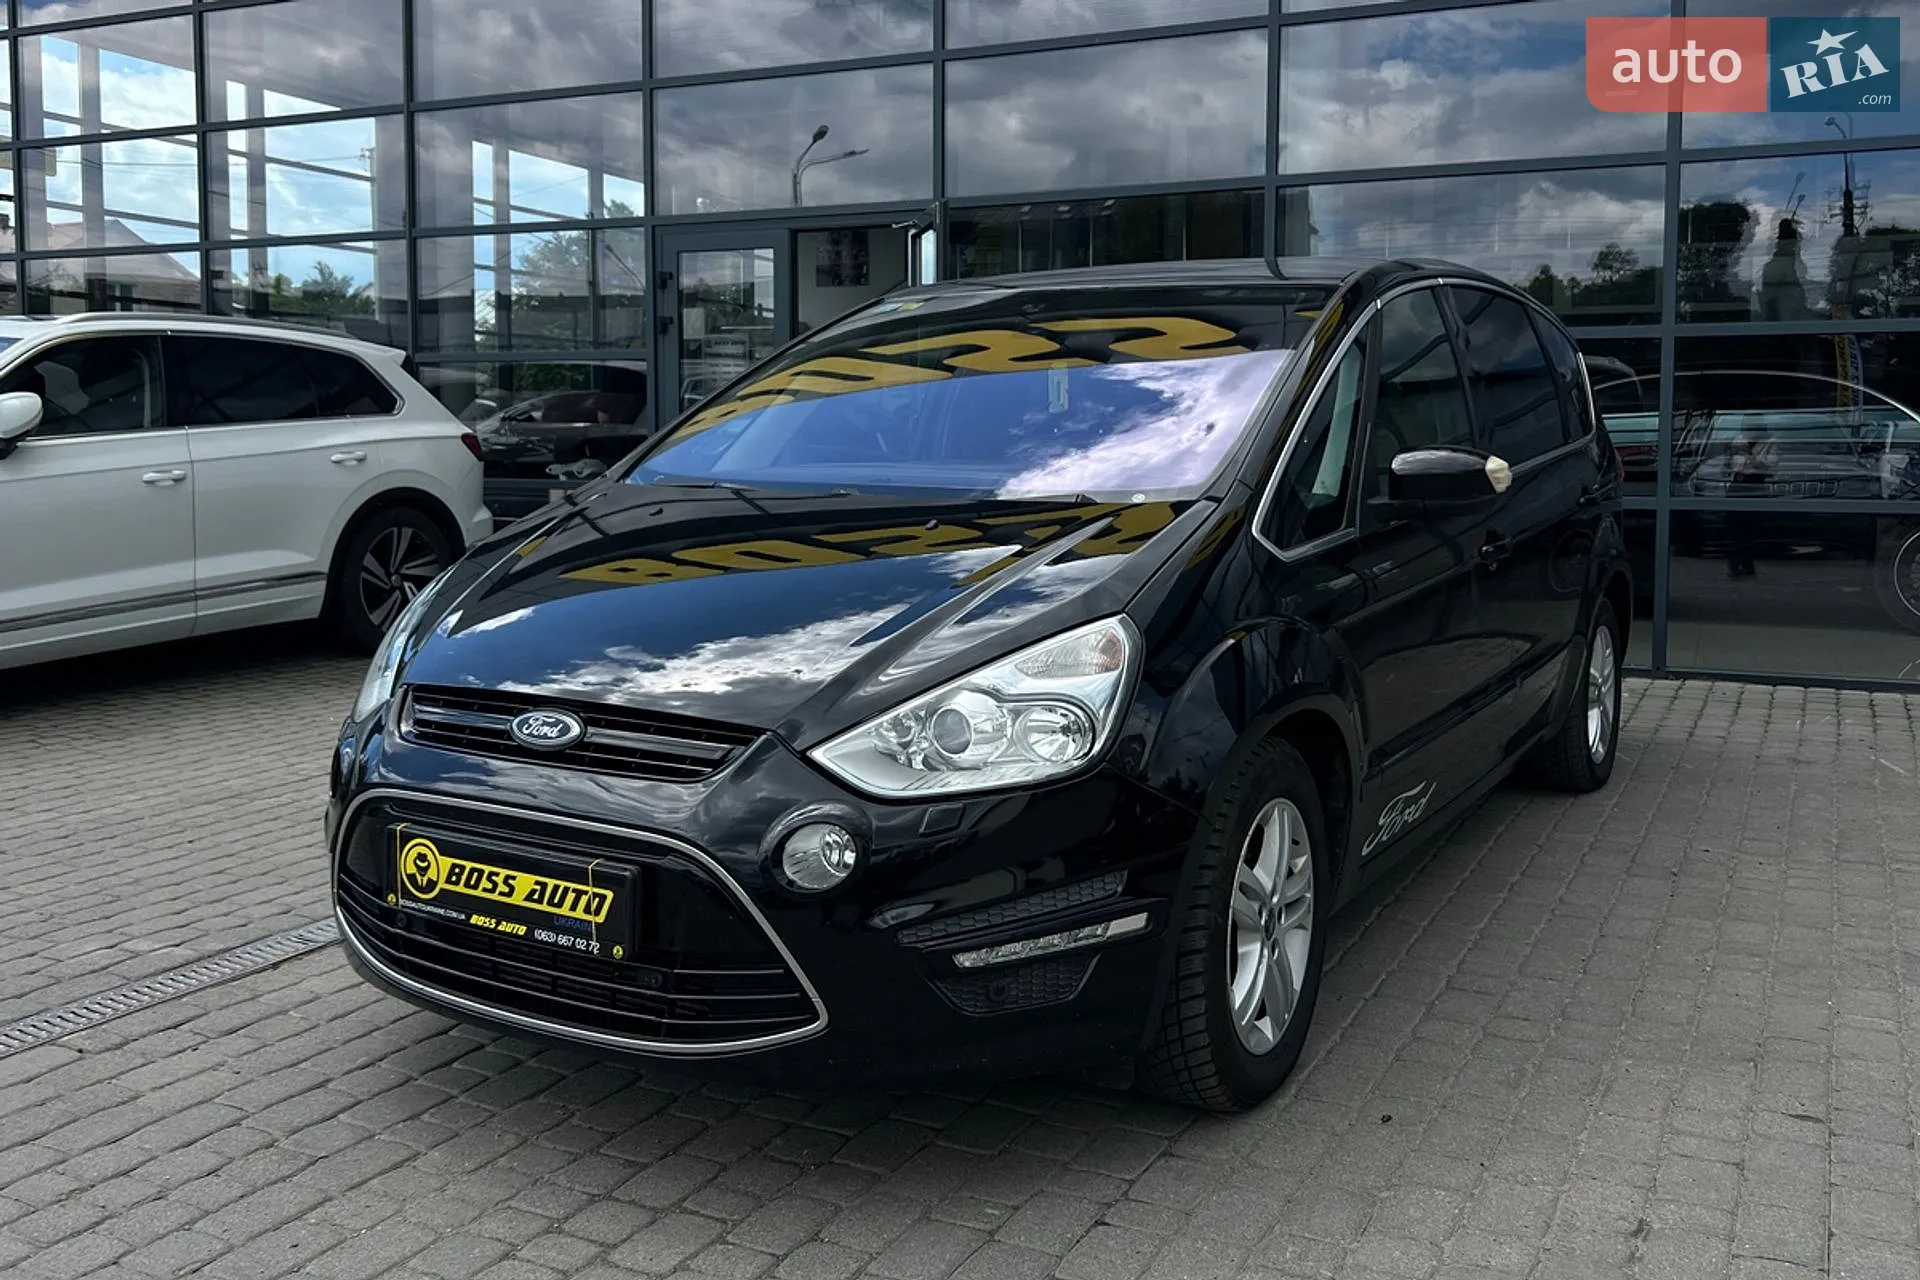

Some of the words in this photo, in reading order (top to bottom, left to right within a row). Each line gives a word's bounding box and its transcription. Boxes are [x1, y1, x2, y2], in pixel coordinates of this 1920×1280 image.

[523, 716, 563, 737] Ford
[1361, 780, 1438, 856] Ford
[445, 862, 517, 898] BOSS
[525, 880, 608, 917] AUTO
[470, 914, 496, 929] BOSS
[497, 921, 527, 936] AUTO
[534, 928, 556, 943] (063)
[575, 939, 587, 951] 02
[588, 940, 600, 955] 72
